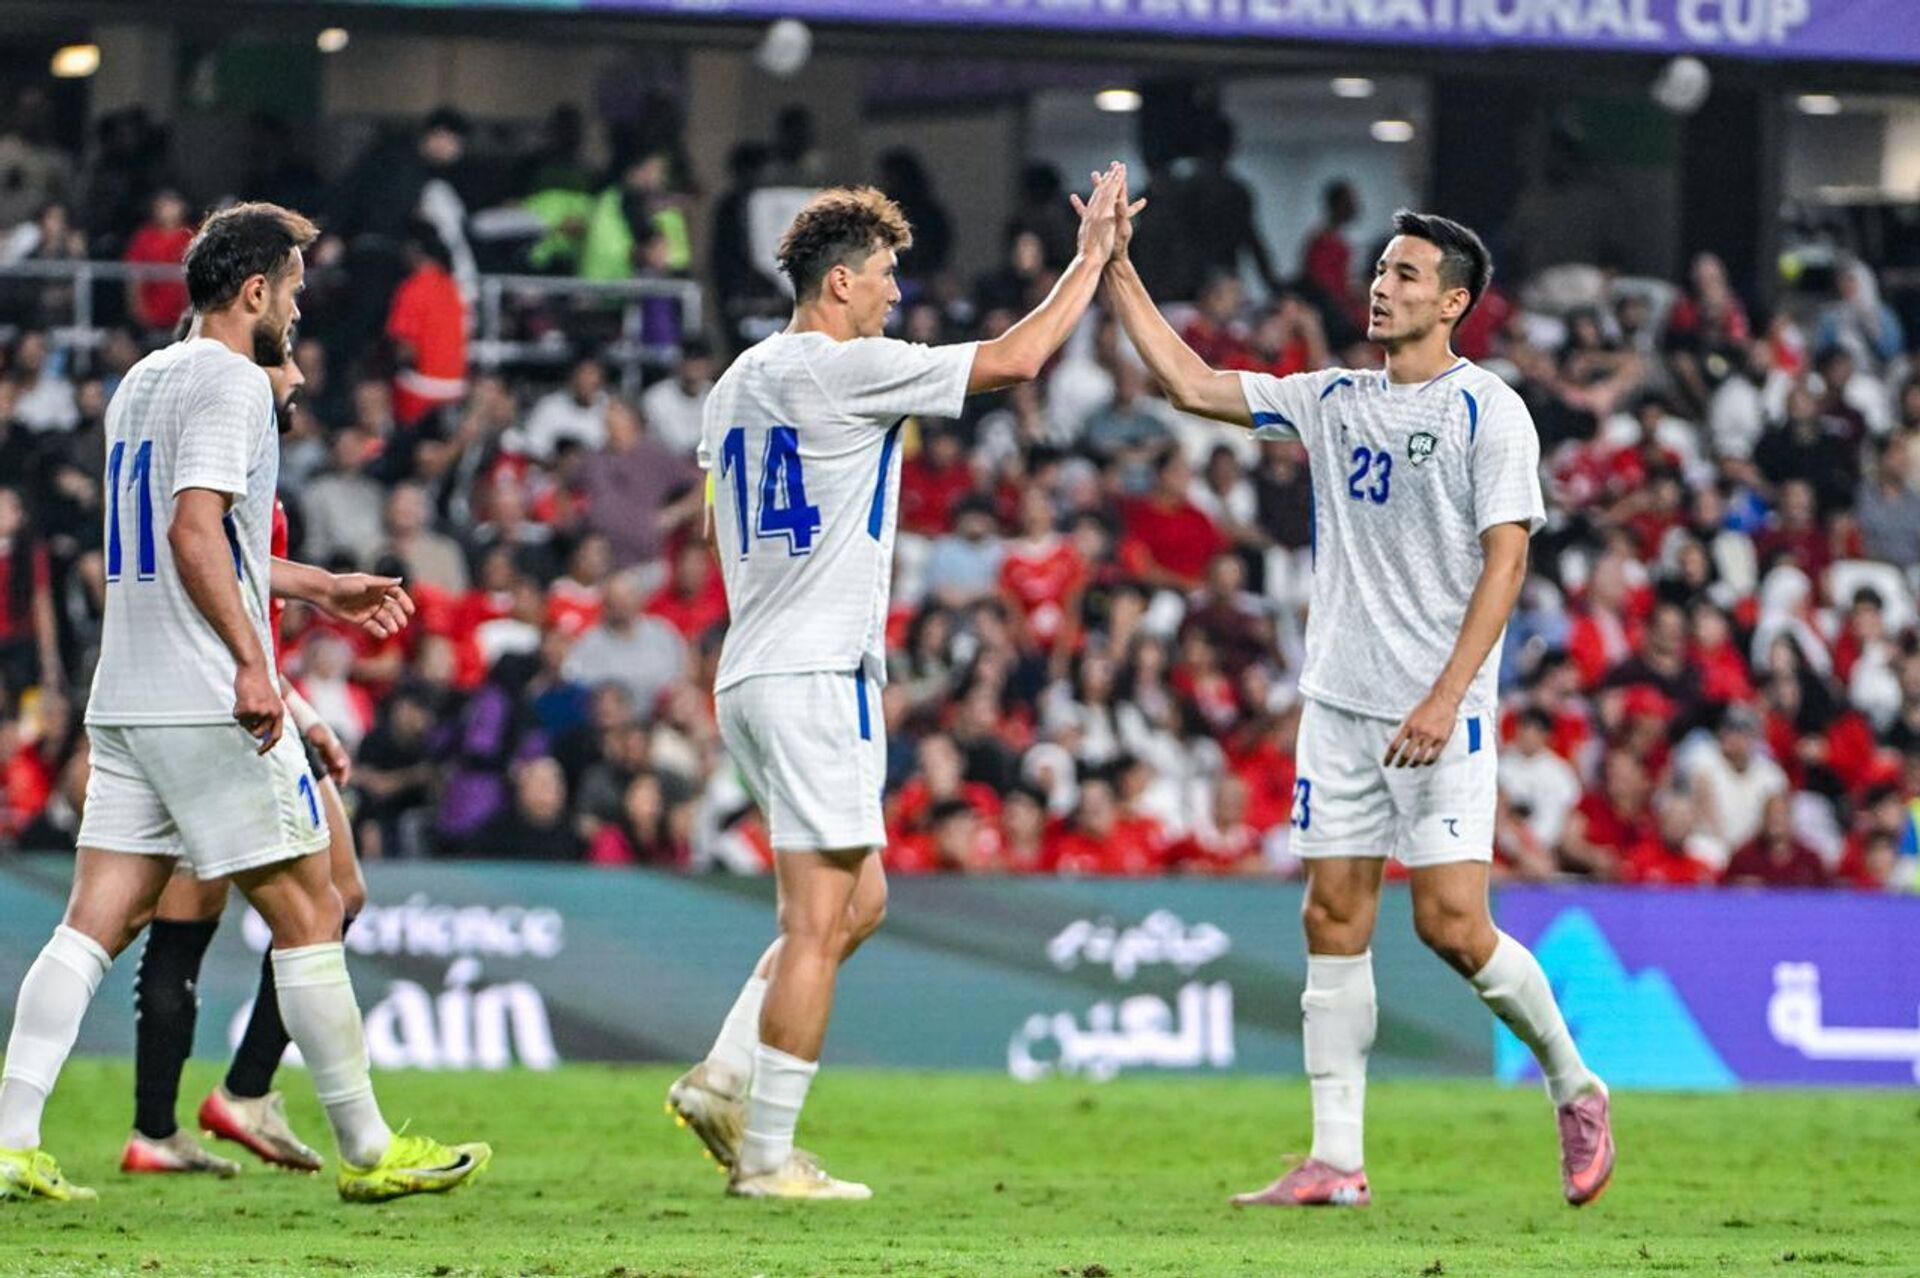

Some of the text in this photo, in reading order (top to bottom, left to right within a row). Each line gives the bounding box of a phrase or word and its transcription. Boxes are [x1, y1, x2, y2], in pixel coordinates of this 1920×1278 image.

[1677, 0, 1811, 45] CUP
[720, 426, 821, 561] 14
[1348, 446, 1392, 505] 23
[107, 440, 155, 582] 11
[1290, 778, 1311, 832] 3
[241, 892, 564, 957] erience
[1008, 980, 1234, 1074] العين
